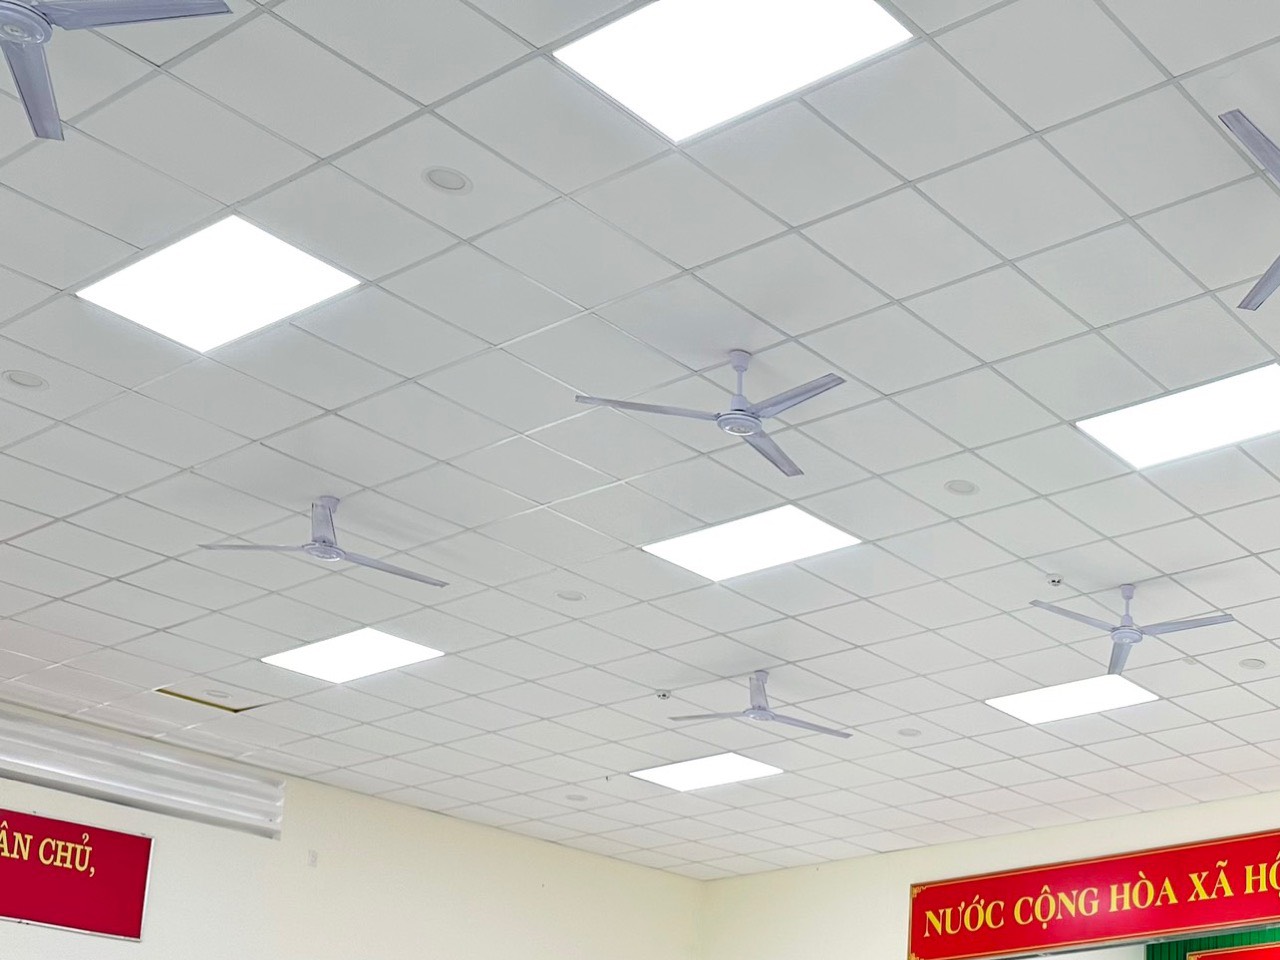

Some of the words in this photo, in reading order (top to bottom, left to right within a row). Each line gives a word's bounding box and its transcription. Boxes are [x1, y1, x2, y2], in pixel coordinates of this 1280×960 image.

[38, 832, 96, 878] CHỦ,
[923, 899, 1004, 938] NƯỚC
[1013, 885, 1100, 931] CỘNG
[1109, 870, 1177, 914] HÒA
[1187, 860, 1234, 902] XÃ
